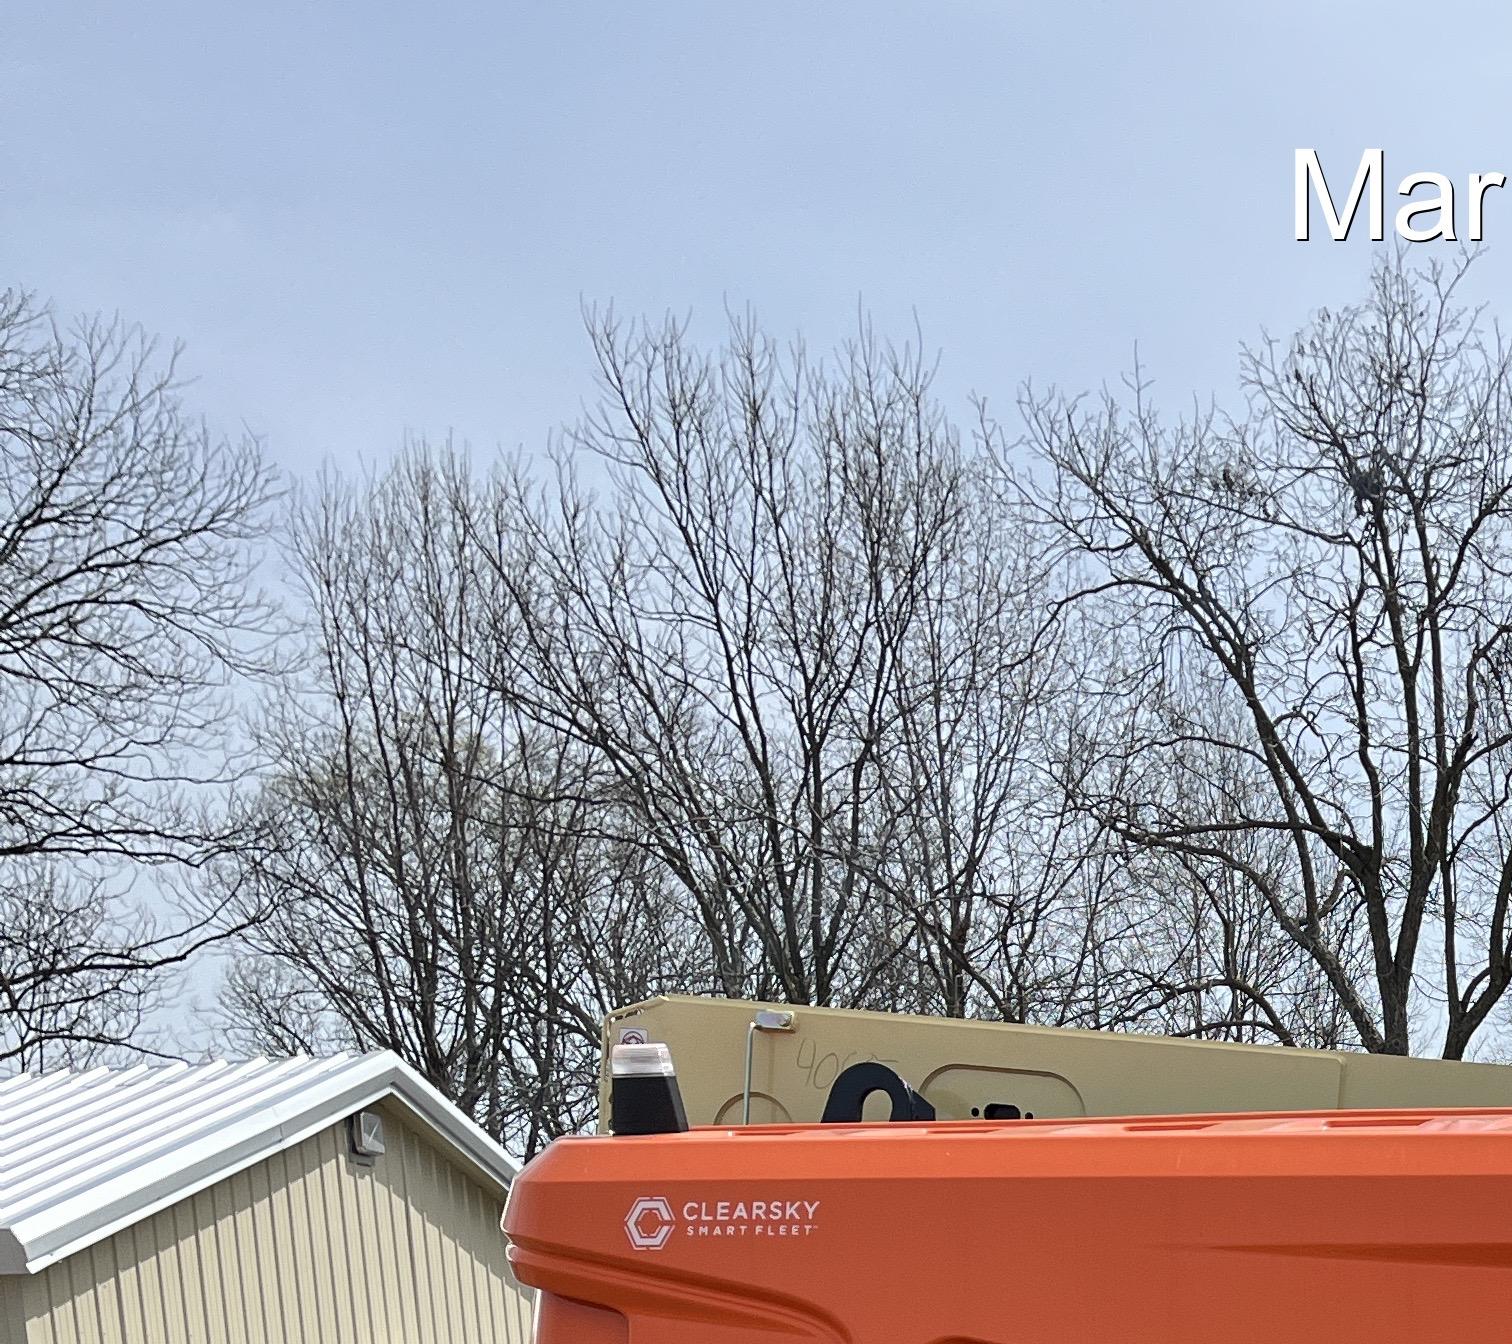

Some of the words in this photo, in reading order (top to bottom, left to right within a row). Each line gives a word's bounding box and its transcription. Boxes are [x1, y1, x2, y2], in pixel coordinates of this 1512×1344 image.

[682, 1200, 821, 1222] CLEARSKY
[686, 1225, 748, 1236] SMART
[755, 1225, 813, 1236] FLEET
